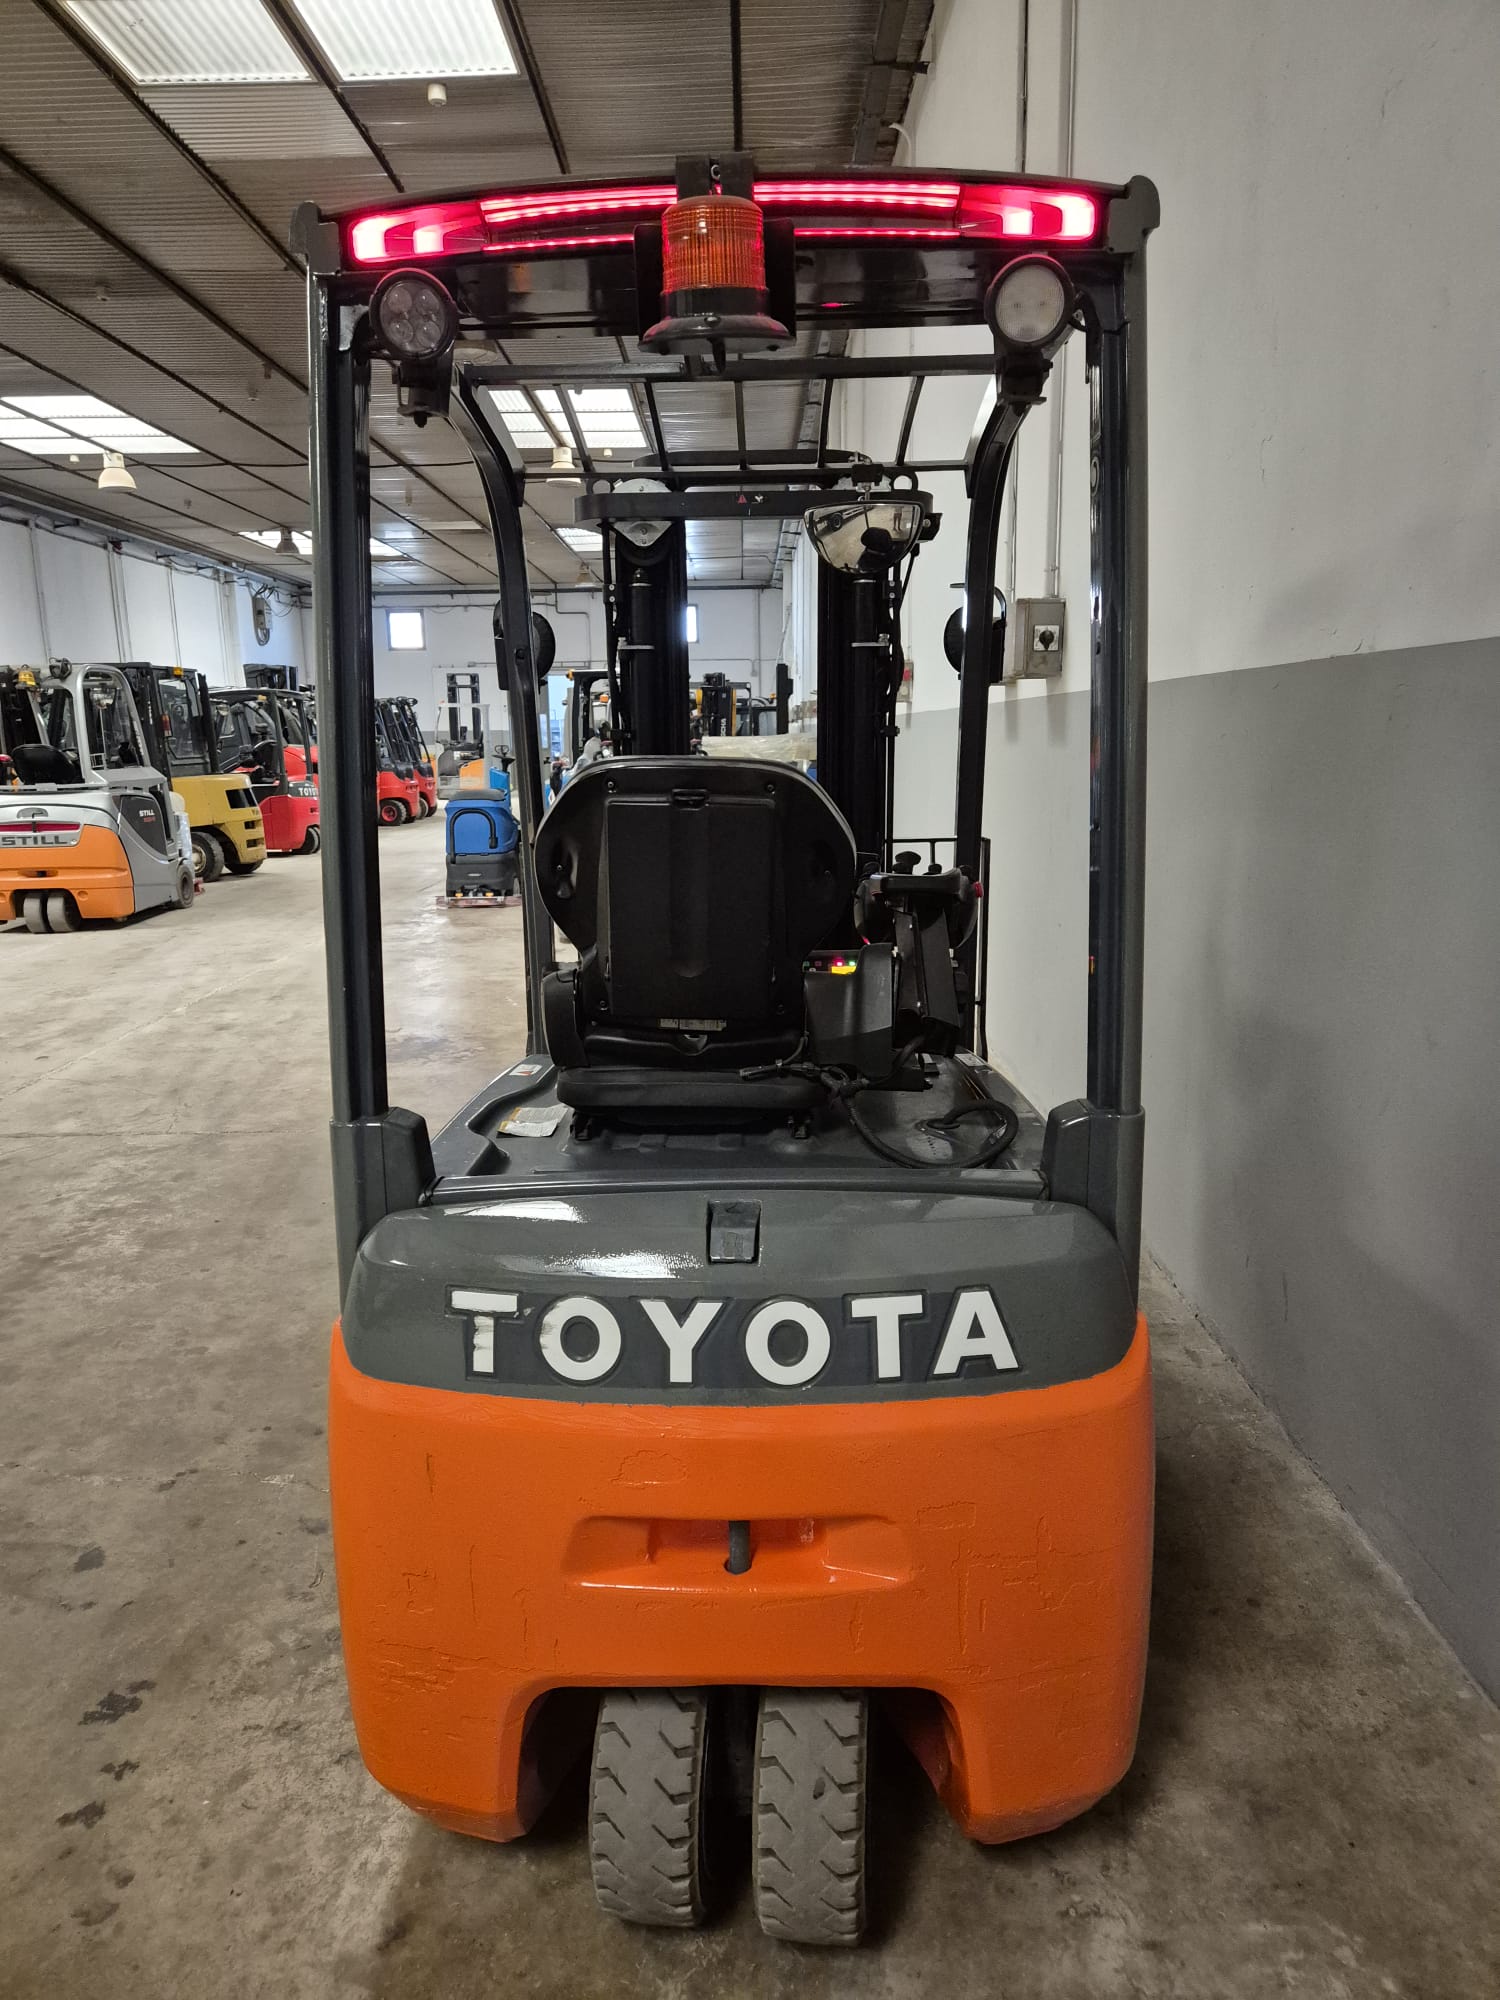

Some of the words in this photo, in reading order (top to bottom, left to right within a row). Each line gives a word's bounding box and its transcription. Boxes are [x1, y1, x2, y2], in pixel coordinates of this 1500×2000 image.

[139, 809, 155, 817] STILL
[1, 835, 68, 846] STILL
[450, 1290, 1018, 1385] TOYOTA
